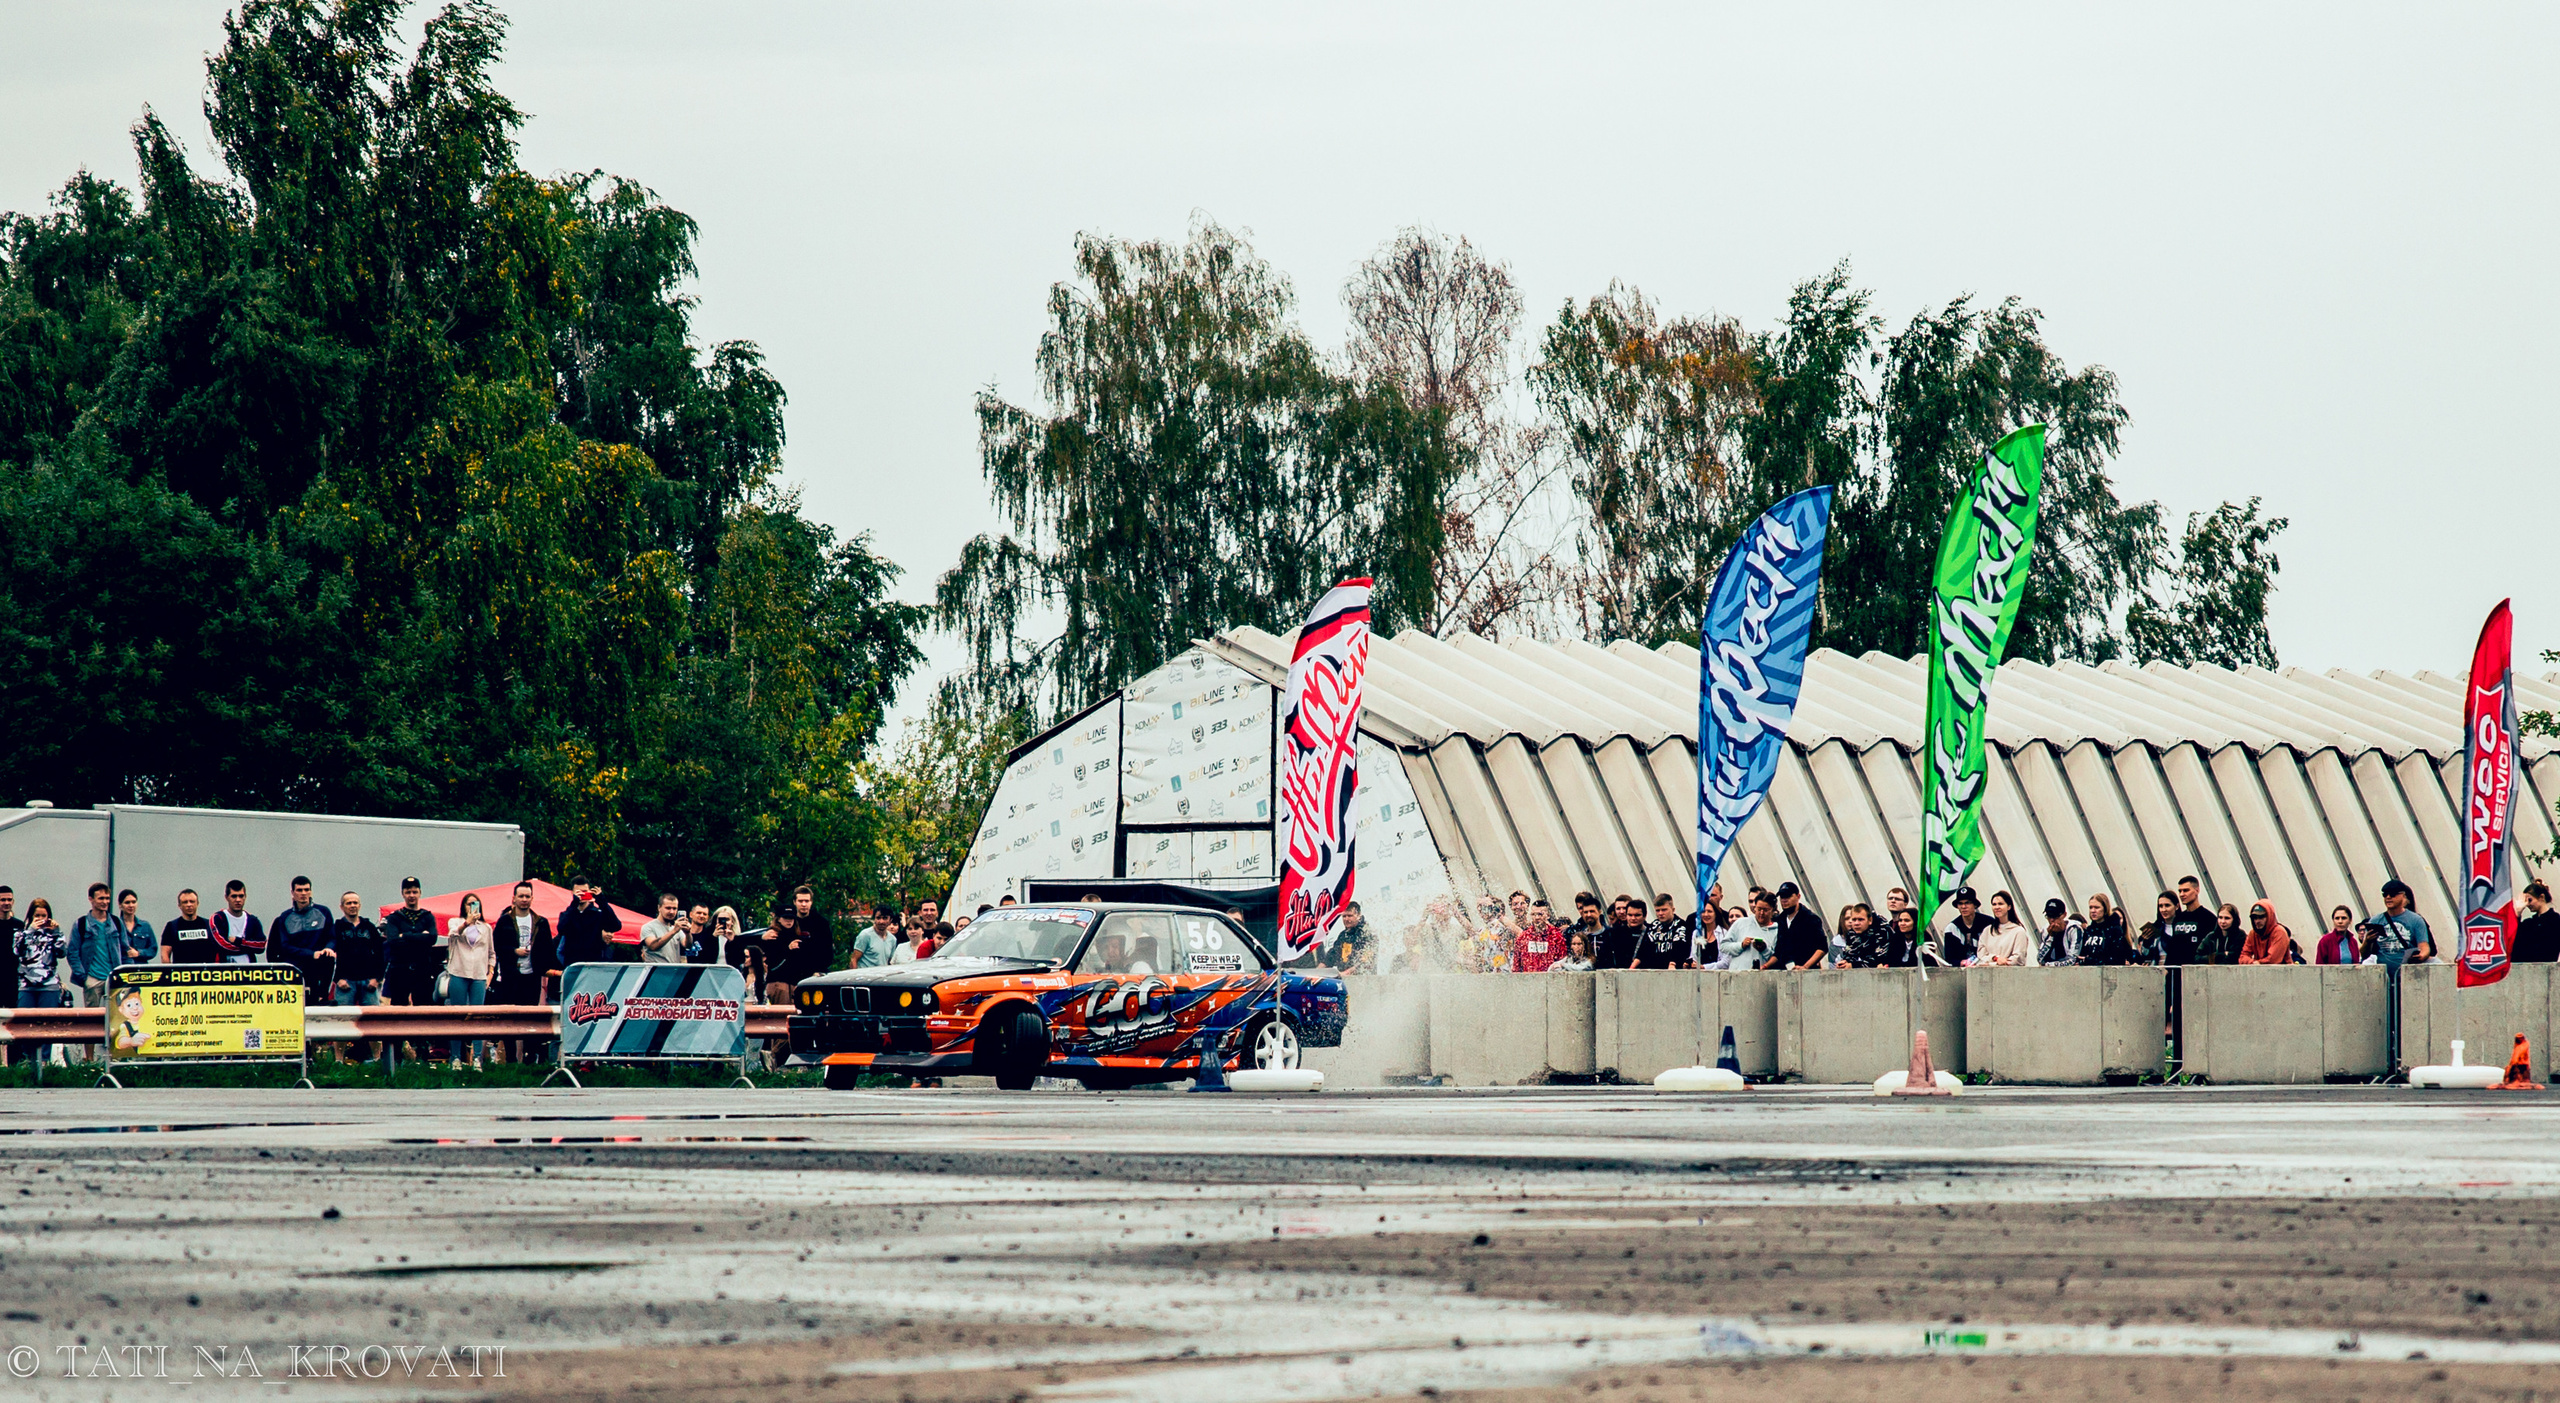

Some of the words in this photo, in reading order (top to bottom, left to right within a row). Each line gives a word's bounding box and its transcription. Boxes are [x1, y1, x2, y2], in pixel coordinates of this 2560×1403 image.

[2493, 740, 2508, 831] SERVICE
[1187, 921, 1223, 950] 56
[1191, 954, 1209, 963] KEEP
[1210, 955, 1218, 963] IN
[1219, 954, 1241, 963] WRAP
[171, 970, 294, 982] АВТОЗАПЧАСТИ
[151, 991, 172, 1006] ВСЕ
[174, 991, 198, 1007] ДЛЯ
[200, 990, 264, 1005] ИНОМАРОК
[266, 993, 273, 1003] и
[276, 990, 297, 1004] ВАЗ
[624, 998, 693, 1007] МЕЖДУНАРОДНЫЙ
[694, 1000, 738, 1008] ФЕСТИВАЛЬ
[624, 1007, 711, 1020] АВТОМОБИЛЕЙ
[714, 1009, 738, 1020] ВАЗ
[156, 1016, 178, 1026] более
[180, 1015, 189, 1025] 20
[190, 1015, 203, 1025] 000
[190, 1029, 207, 1037] цены
[156, 1040, 183, 1048] широкий
[184, 1039, 223, 1047] ассортимент
